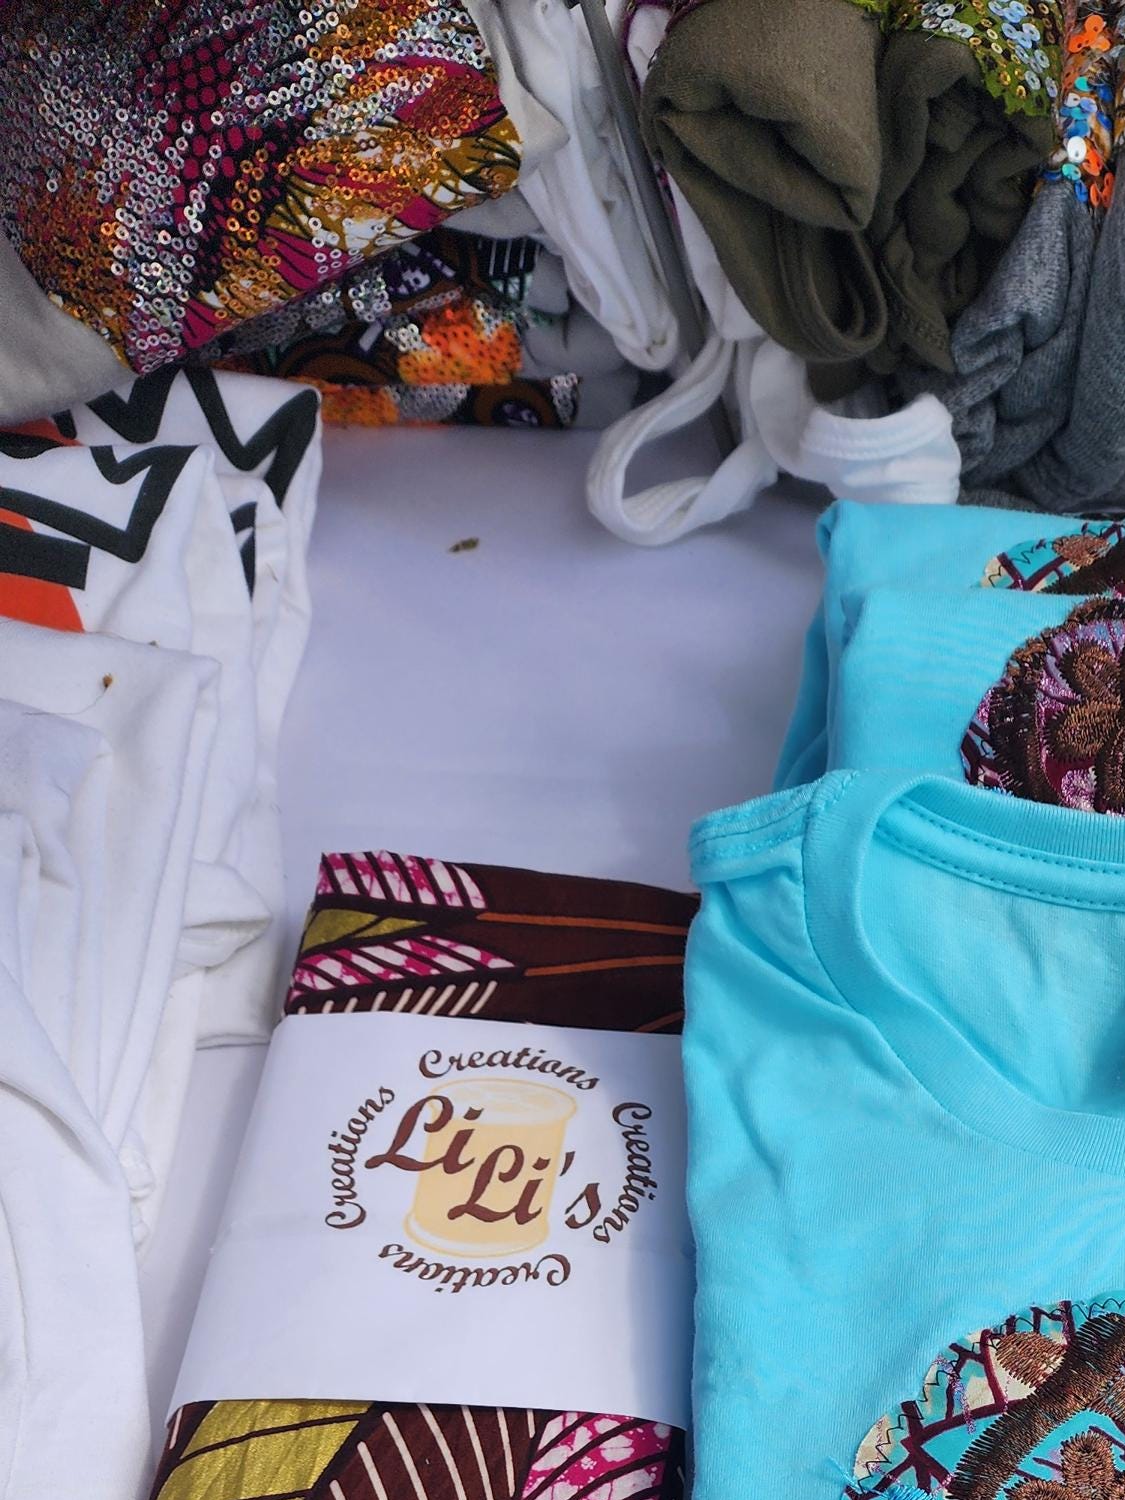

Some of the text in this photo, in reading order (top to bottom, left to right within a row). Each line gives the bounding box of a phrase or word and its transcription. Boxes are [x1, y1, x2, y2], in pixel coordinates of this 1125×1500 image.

[418, 1047, 600, 1091] Creations
[324, 1086, 396, 1230] Creations
[364, 1094, 484, 1175] Li
[592, 1102, 659, 1244] Creations
[447, 1143, 603, 1230] Li's
[378, 1242, 572, 1294] Creations
